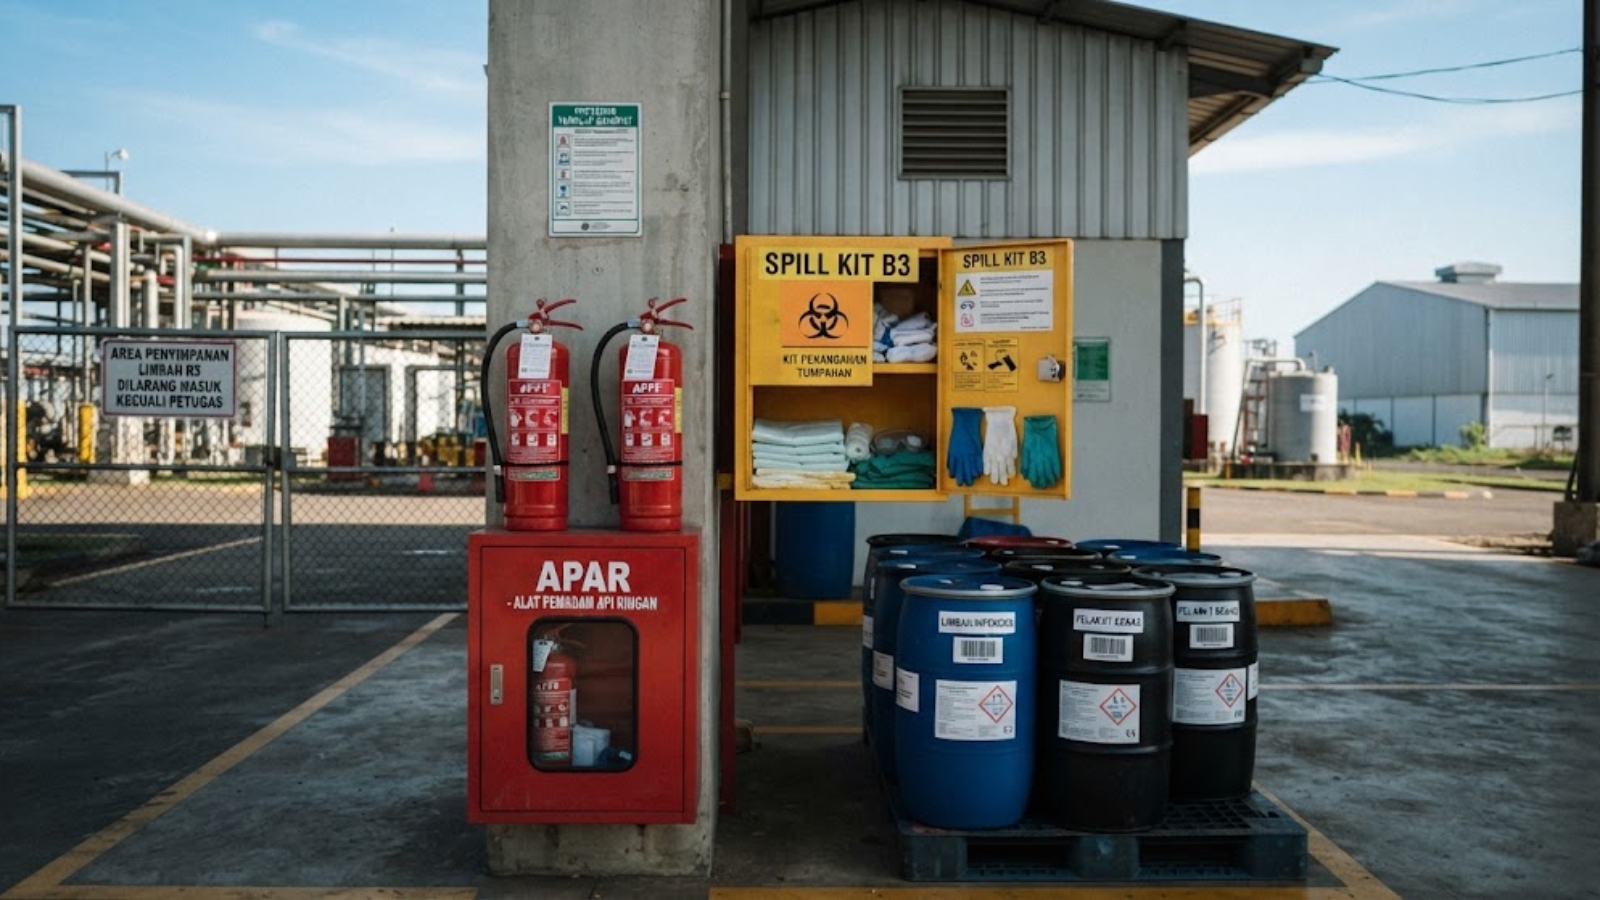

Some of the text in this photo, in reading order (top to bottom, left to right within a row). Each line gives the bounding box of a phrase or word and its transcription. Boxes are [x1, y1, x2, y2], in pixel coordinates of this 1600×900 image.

[765, 252, 910, 276] SPILL KIT B3
[963, 250, 1046, 269] SPILL KIT B3
[110, 347, 229, 362] AREA PENYIMPANAN
[783, 354, 798, 364] KIT
[796, 368, 852, 378] TUMPAHAN
[118, 379, 176, 392] DILARANG
[169, 395, 223, 409] PETUGAS
[535, 560, 631, 593] APAR
[513, 595, 541, 609] ALAT
[596, 596, 614, 610] API
